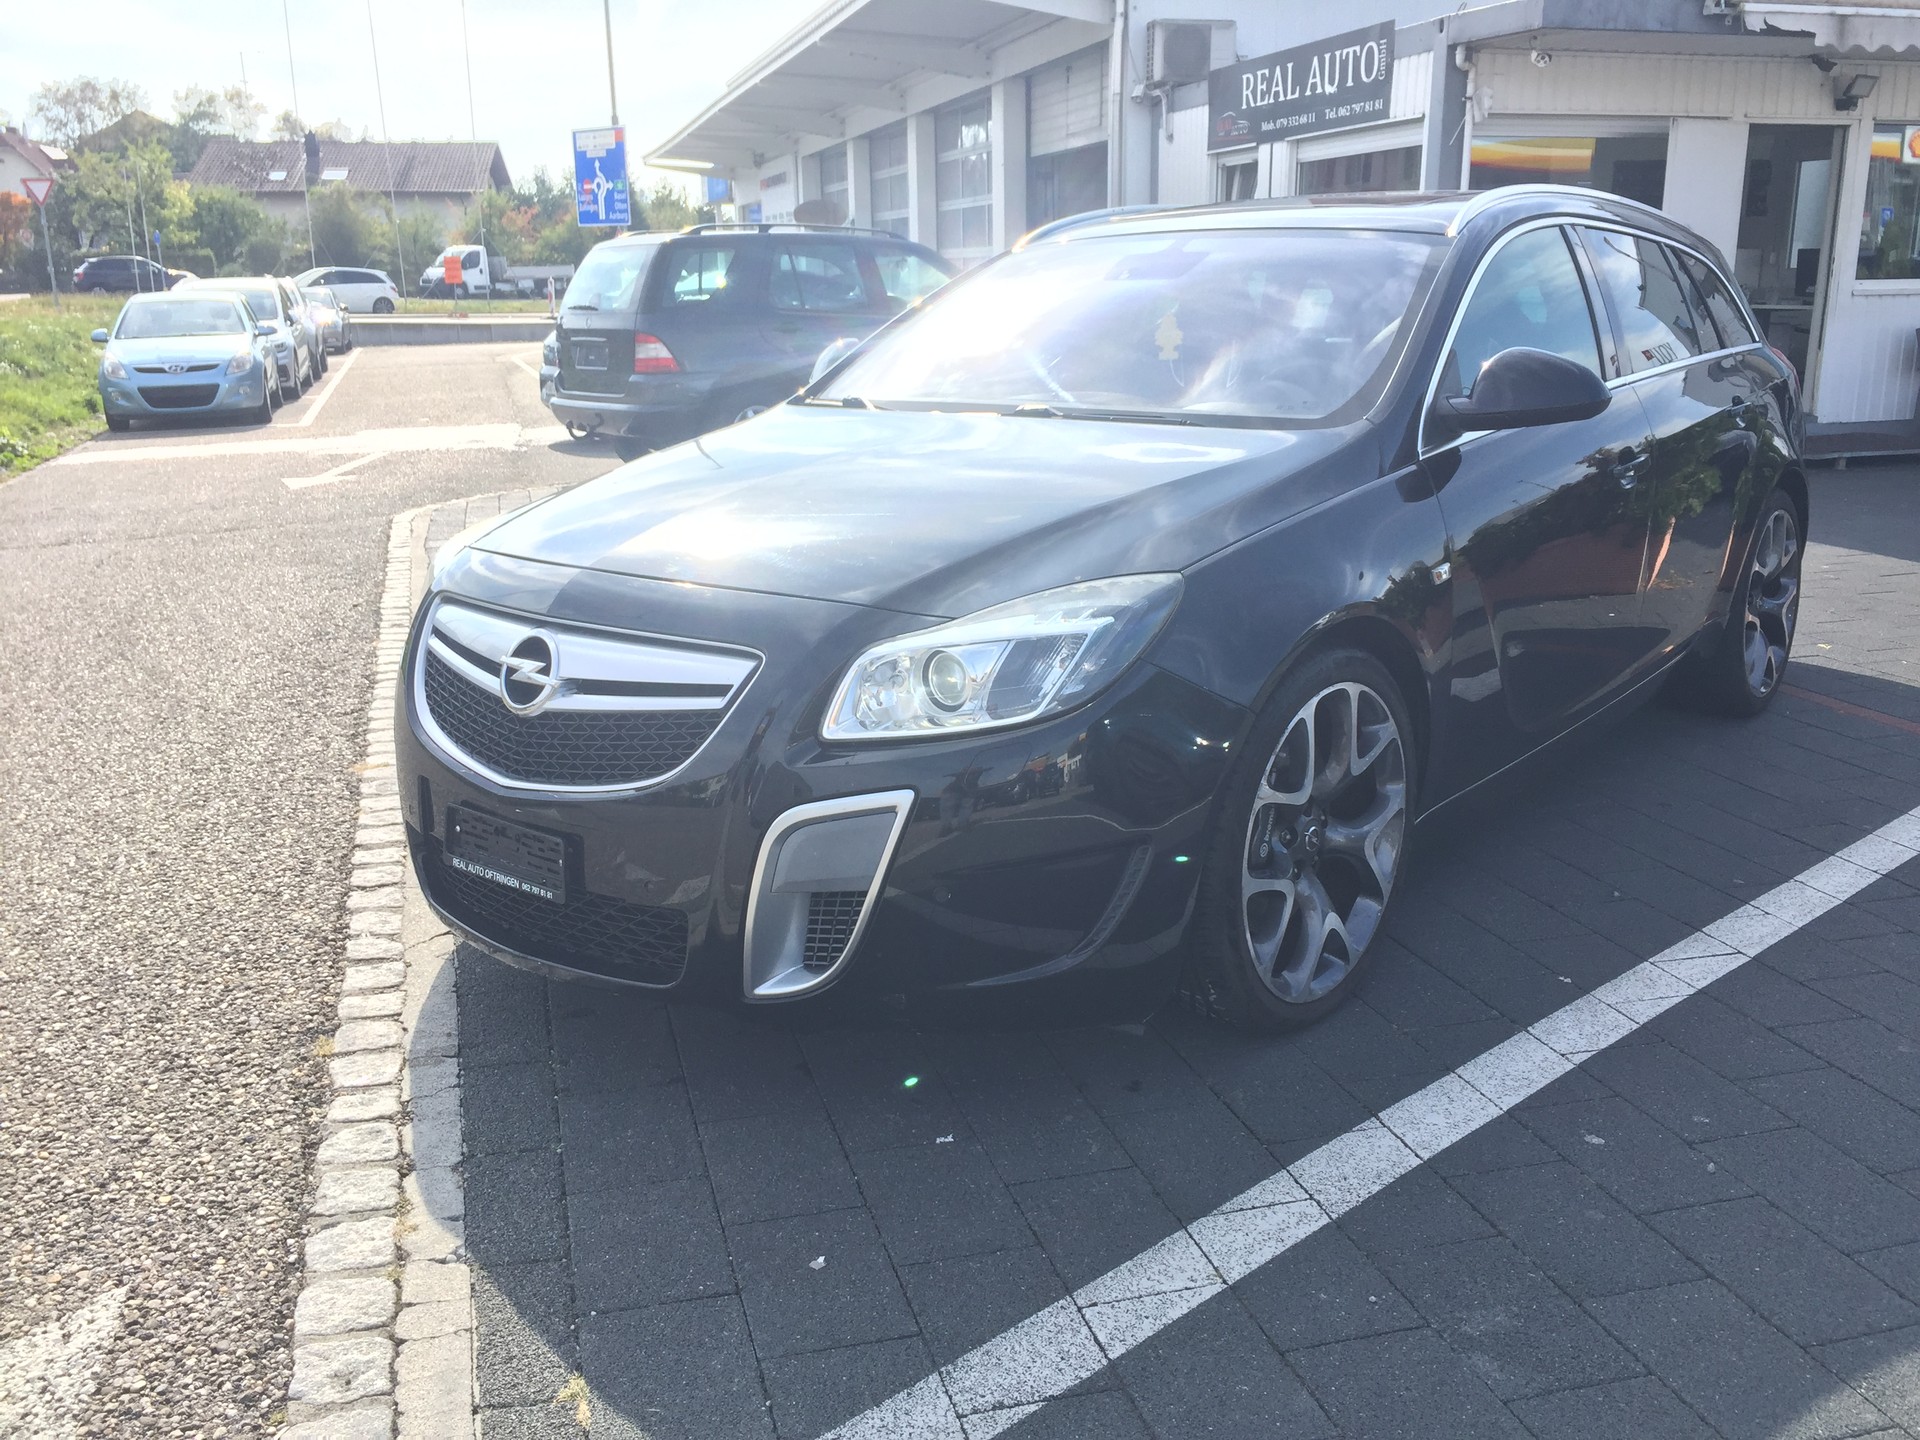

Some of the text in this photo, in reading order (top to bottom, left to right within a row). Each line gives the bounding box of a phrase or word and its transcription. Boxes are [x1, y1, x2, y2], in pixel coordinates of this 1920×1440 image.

[1241, 41, 1379, 109] REAL AUTO
[1377, 38, 1387, 80] GmbH
[1261, 120, 1276, 131] Mob.
[1276, 117, 1287, 128] 079
[1325, 99, 1384, 119] Tel. 062 797 81 81
[1263, 804, 1275, 841] bremb
[452, 858, 467, 870] REAL
[467, 863, 485, 876] AUTO
[485, 869, 520, 888] OFTRINGEN
